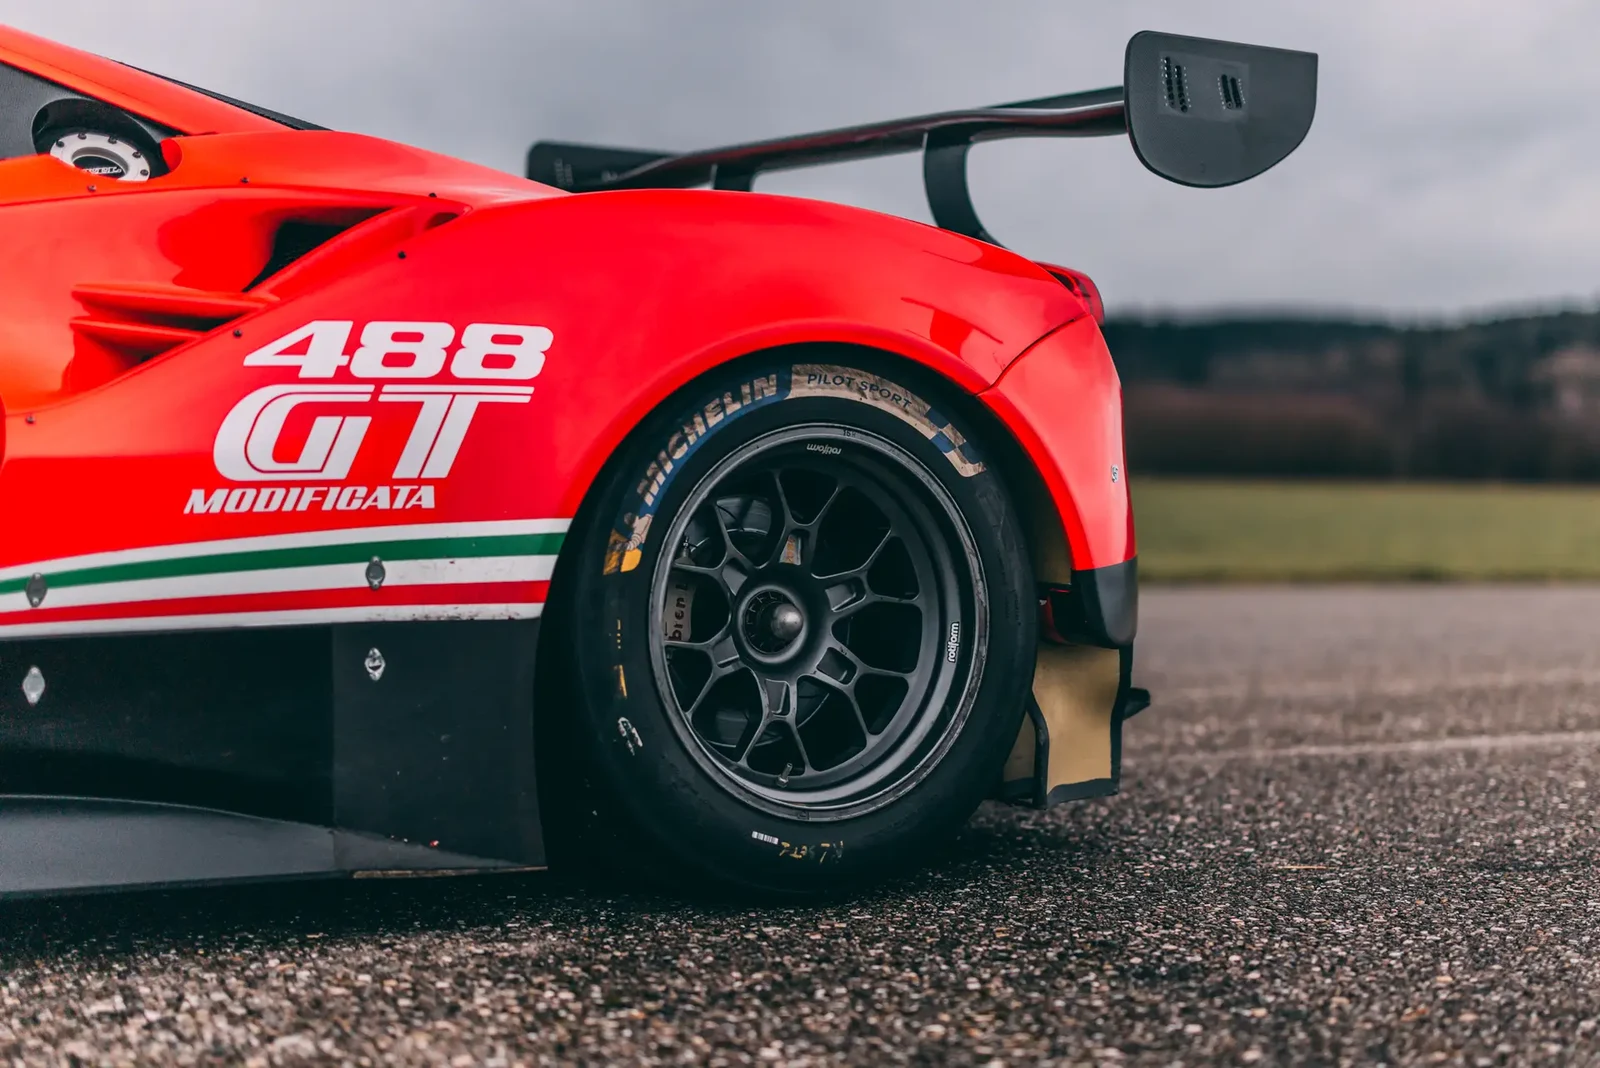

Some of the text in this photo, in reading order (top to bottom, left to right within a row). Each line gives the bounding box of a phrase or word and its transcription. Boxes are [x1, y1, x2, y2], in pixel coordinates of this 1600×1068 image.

[243, 320, 554, 380] 488
[807, 373, 913, 408] PILOT SPORT
[212, 384, 535, 482] GT
[636, 374, 778, 507] MICHELIN
[806, 443, 842, 455] rotiform
[183, 485, 436, 514] MODIFICATA
[947, 622, 960, 662] rotiform
